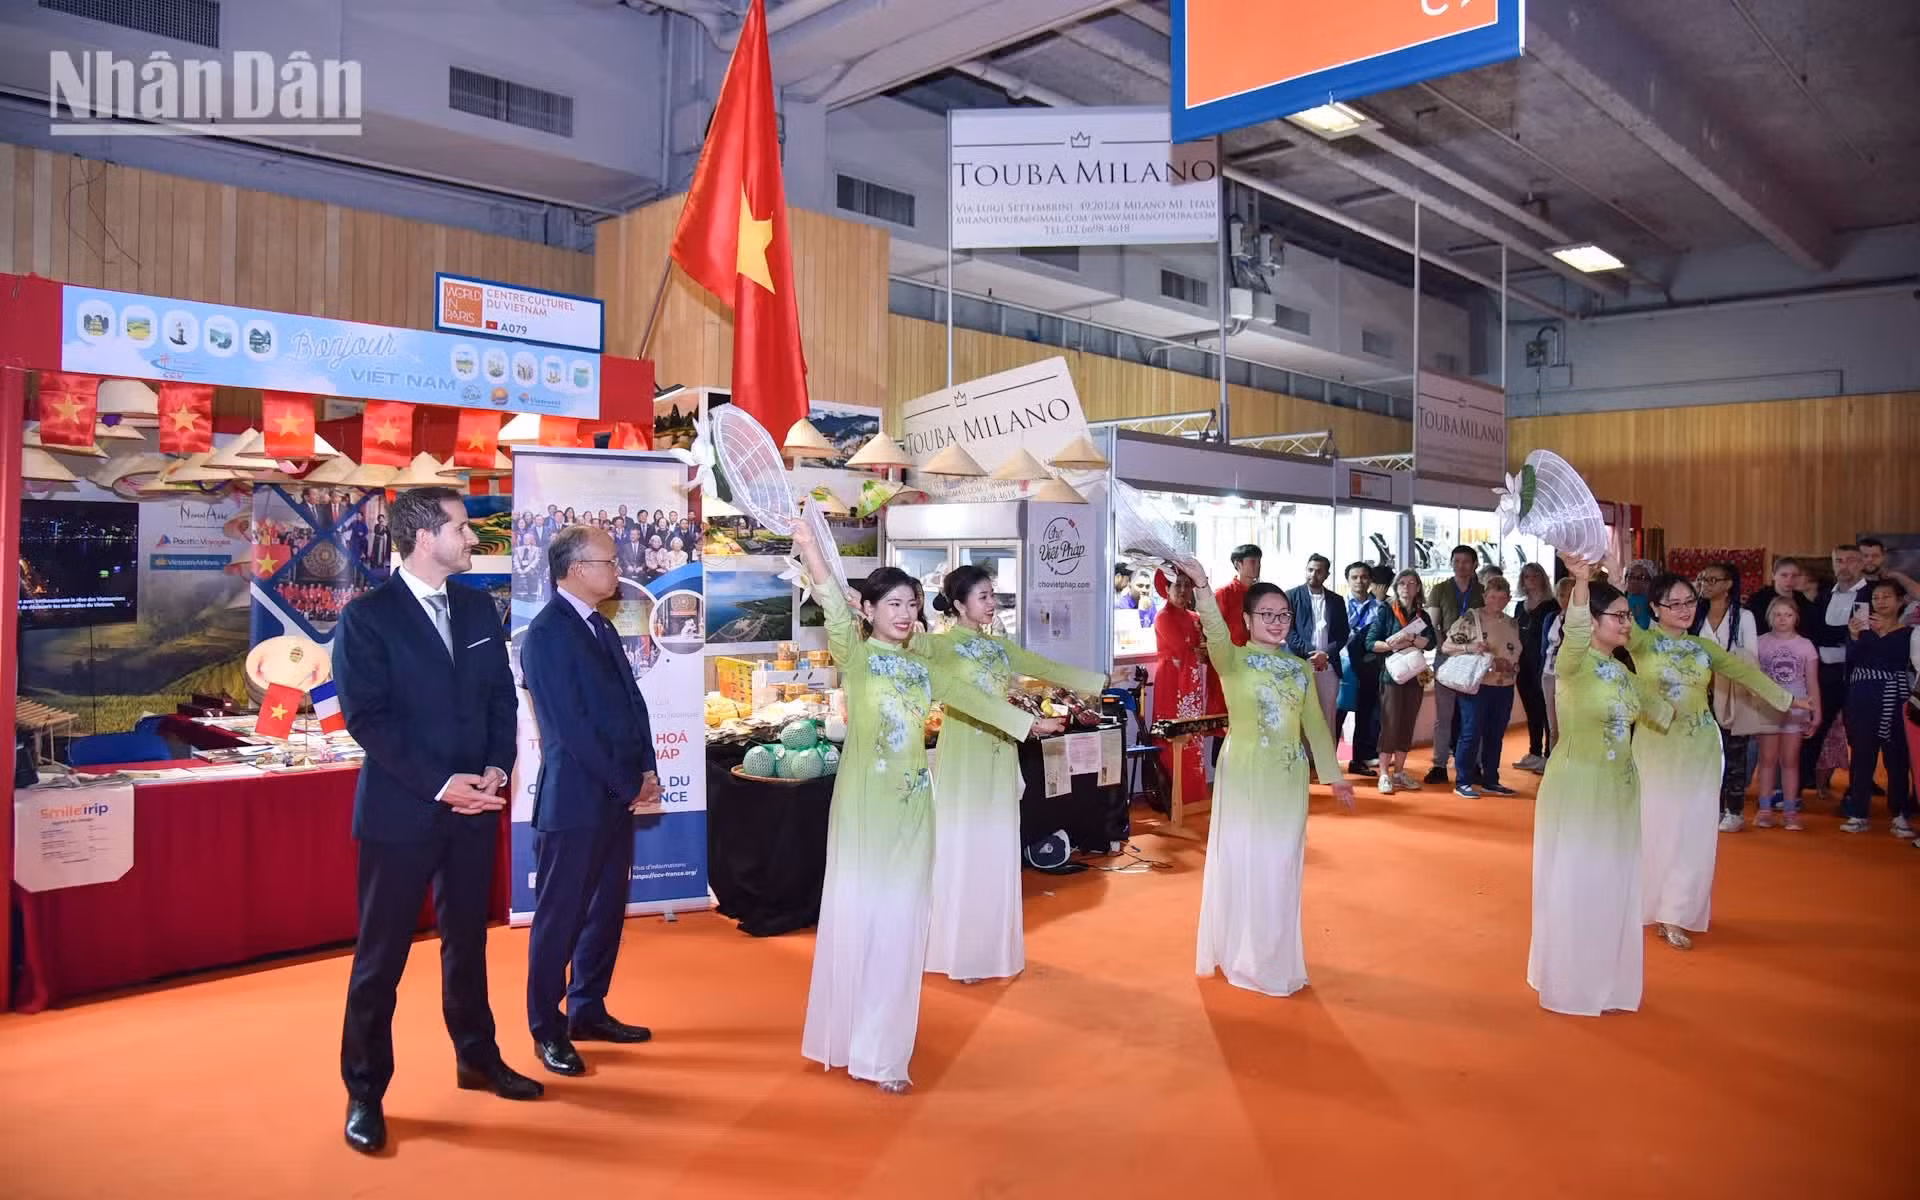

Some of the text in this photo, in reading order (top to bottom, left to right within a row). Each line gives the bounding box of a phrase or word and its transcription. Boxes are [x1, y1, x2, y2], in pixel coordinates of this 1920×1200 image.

[953, 159, 1215, 186] TOUBA MILANO
[1190, 199, 1216, 209] ITALY
[1108, 224, 1130, 233] 4618
[445, 287, 481, 300] WORLD
[486, 289, 575, 311] CENTRE CULTUREL
[445, 298, 458, 309] IN
[487, 300, 547, 316] DU VIETNAM
[445, 309, 475, 323] PARIS
[500, 323, 527, 335] A079
[293, 330, 397, 369] Bonjour
[406, 374, 457, 390] NAM
[905, 398, 1070, 457] TOUBA MILANO
[1417, 406, 1504, 445] TOUBA MILANO
[1038, 581, 1090, 589] chovietphap.com
[656, 730, 688, 744] HOÁ
[669, 775, 690, 787] DU
